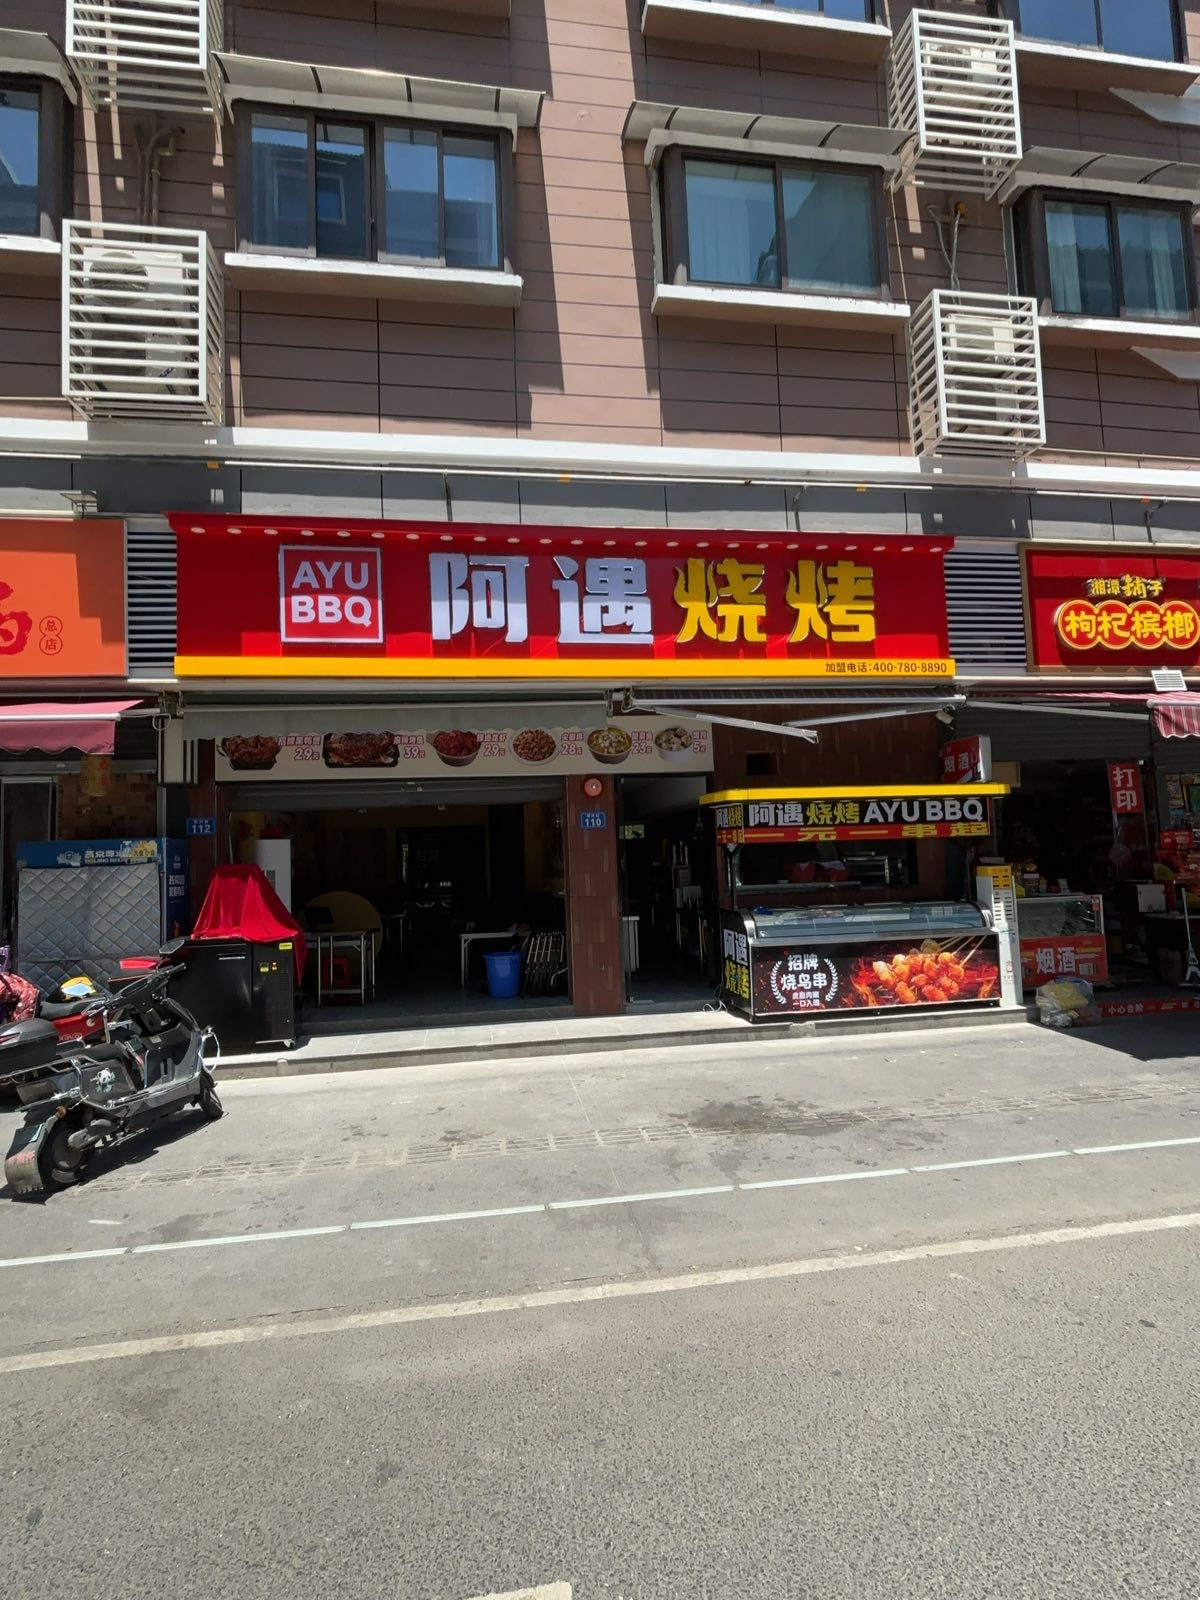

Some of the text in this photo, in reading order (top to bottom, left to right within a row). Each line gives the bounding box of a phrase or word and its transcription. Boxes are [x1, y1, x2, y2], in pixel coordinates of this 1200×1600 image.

[292, 561, 368, 590] AYU
[292, 595, 371, 627] BBQ
[428, 552, 876, 643] 阿遇烧烤
[45, 619, 57, 650] 总店
[1064, 609, 1195, 640] 枸杞槟榔
[1112, 766, 1137, 810] 打印
[584, 818, 602, 827] 110
[748, 799, 983, 827] 阿遇烧烤 AYU BBQ
[192, 824, 211, 834] 112
[723, 929, 748, 966] 阿遇
[787, 953, 819, 971] 招牌
[1036, 946, 1077, 974] 烟酒
[725, 959, 750, 999] 烧烤
[781, 972, 828, 991] 烧鸟串
[1108, 1002, 1145, 1015] 小心台阶
